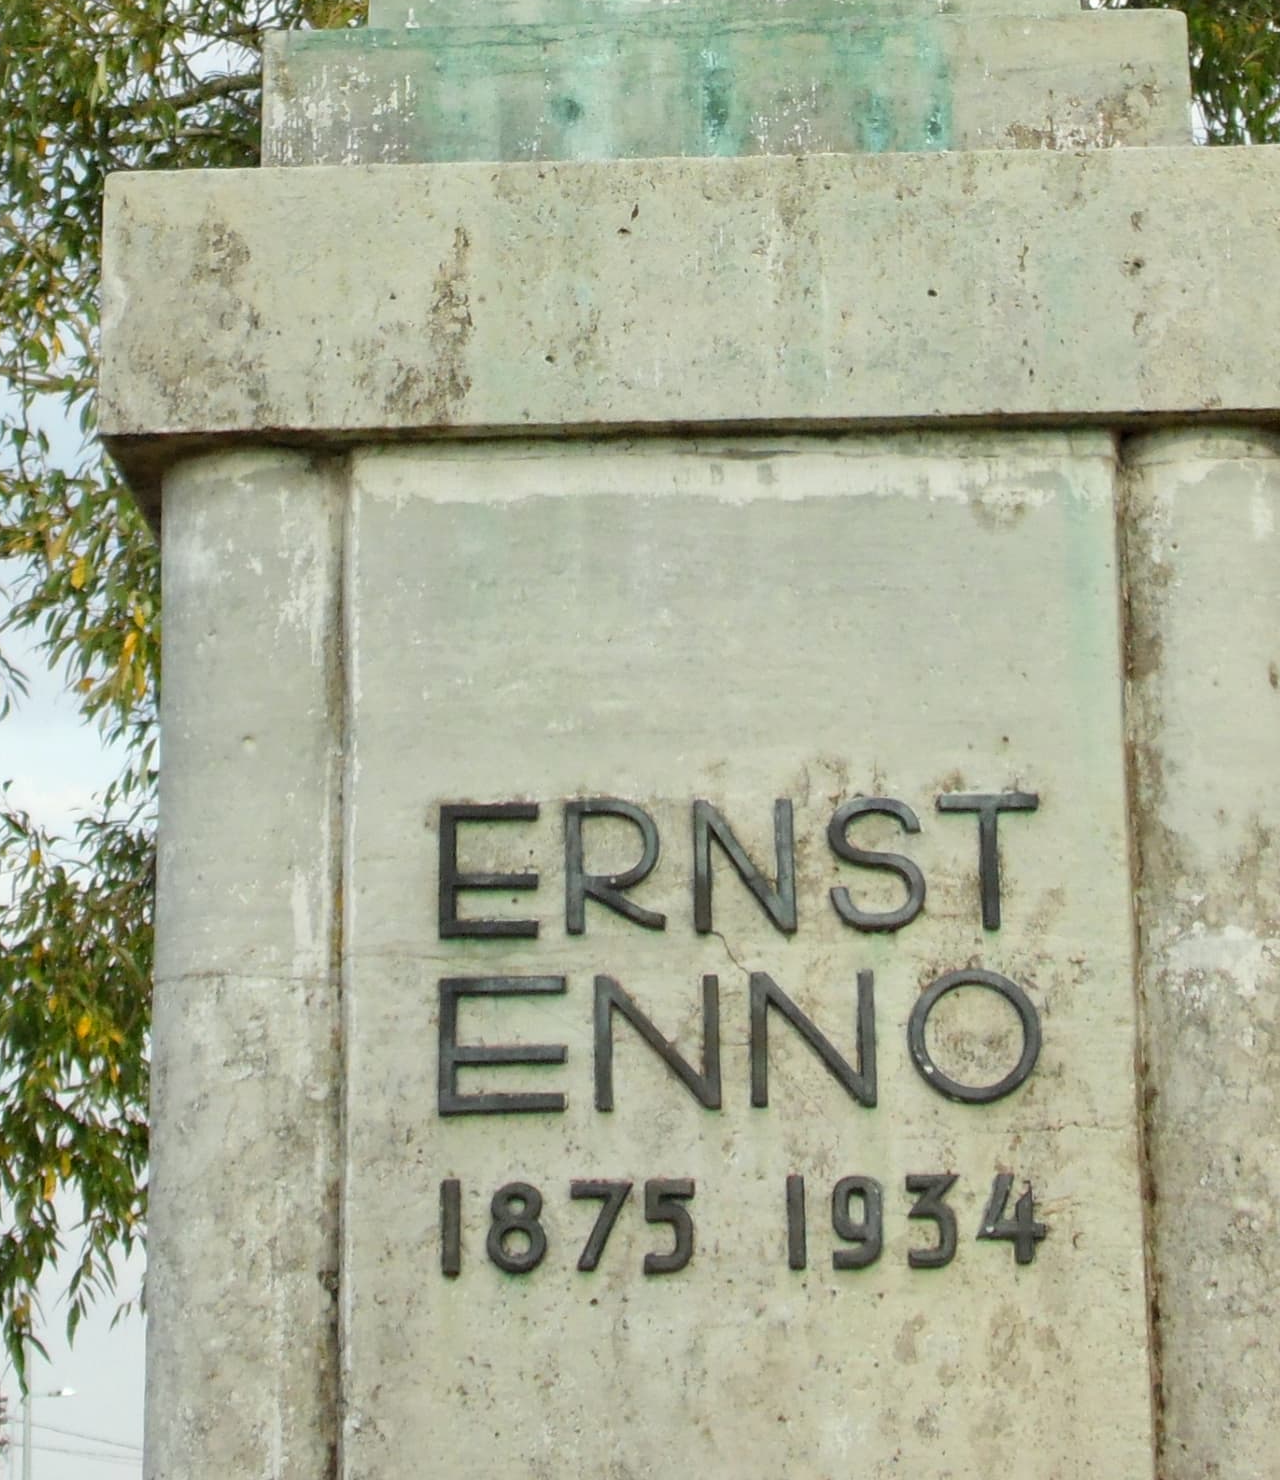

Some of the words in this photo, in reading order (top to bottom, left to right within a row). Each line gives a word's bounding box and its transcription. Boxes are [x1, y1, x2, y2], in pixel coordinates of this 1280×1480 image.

[439, 792, 1039, 939] ERNST
[437, 968, 1042, 1116] ENNO
[440, 1179, 696, 1278] 1875
[786, 1173, 1047, 1271] 1934
